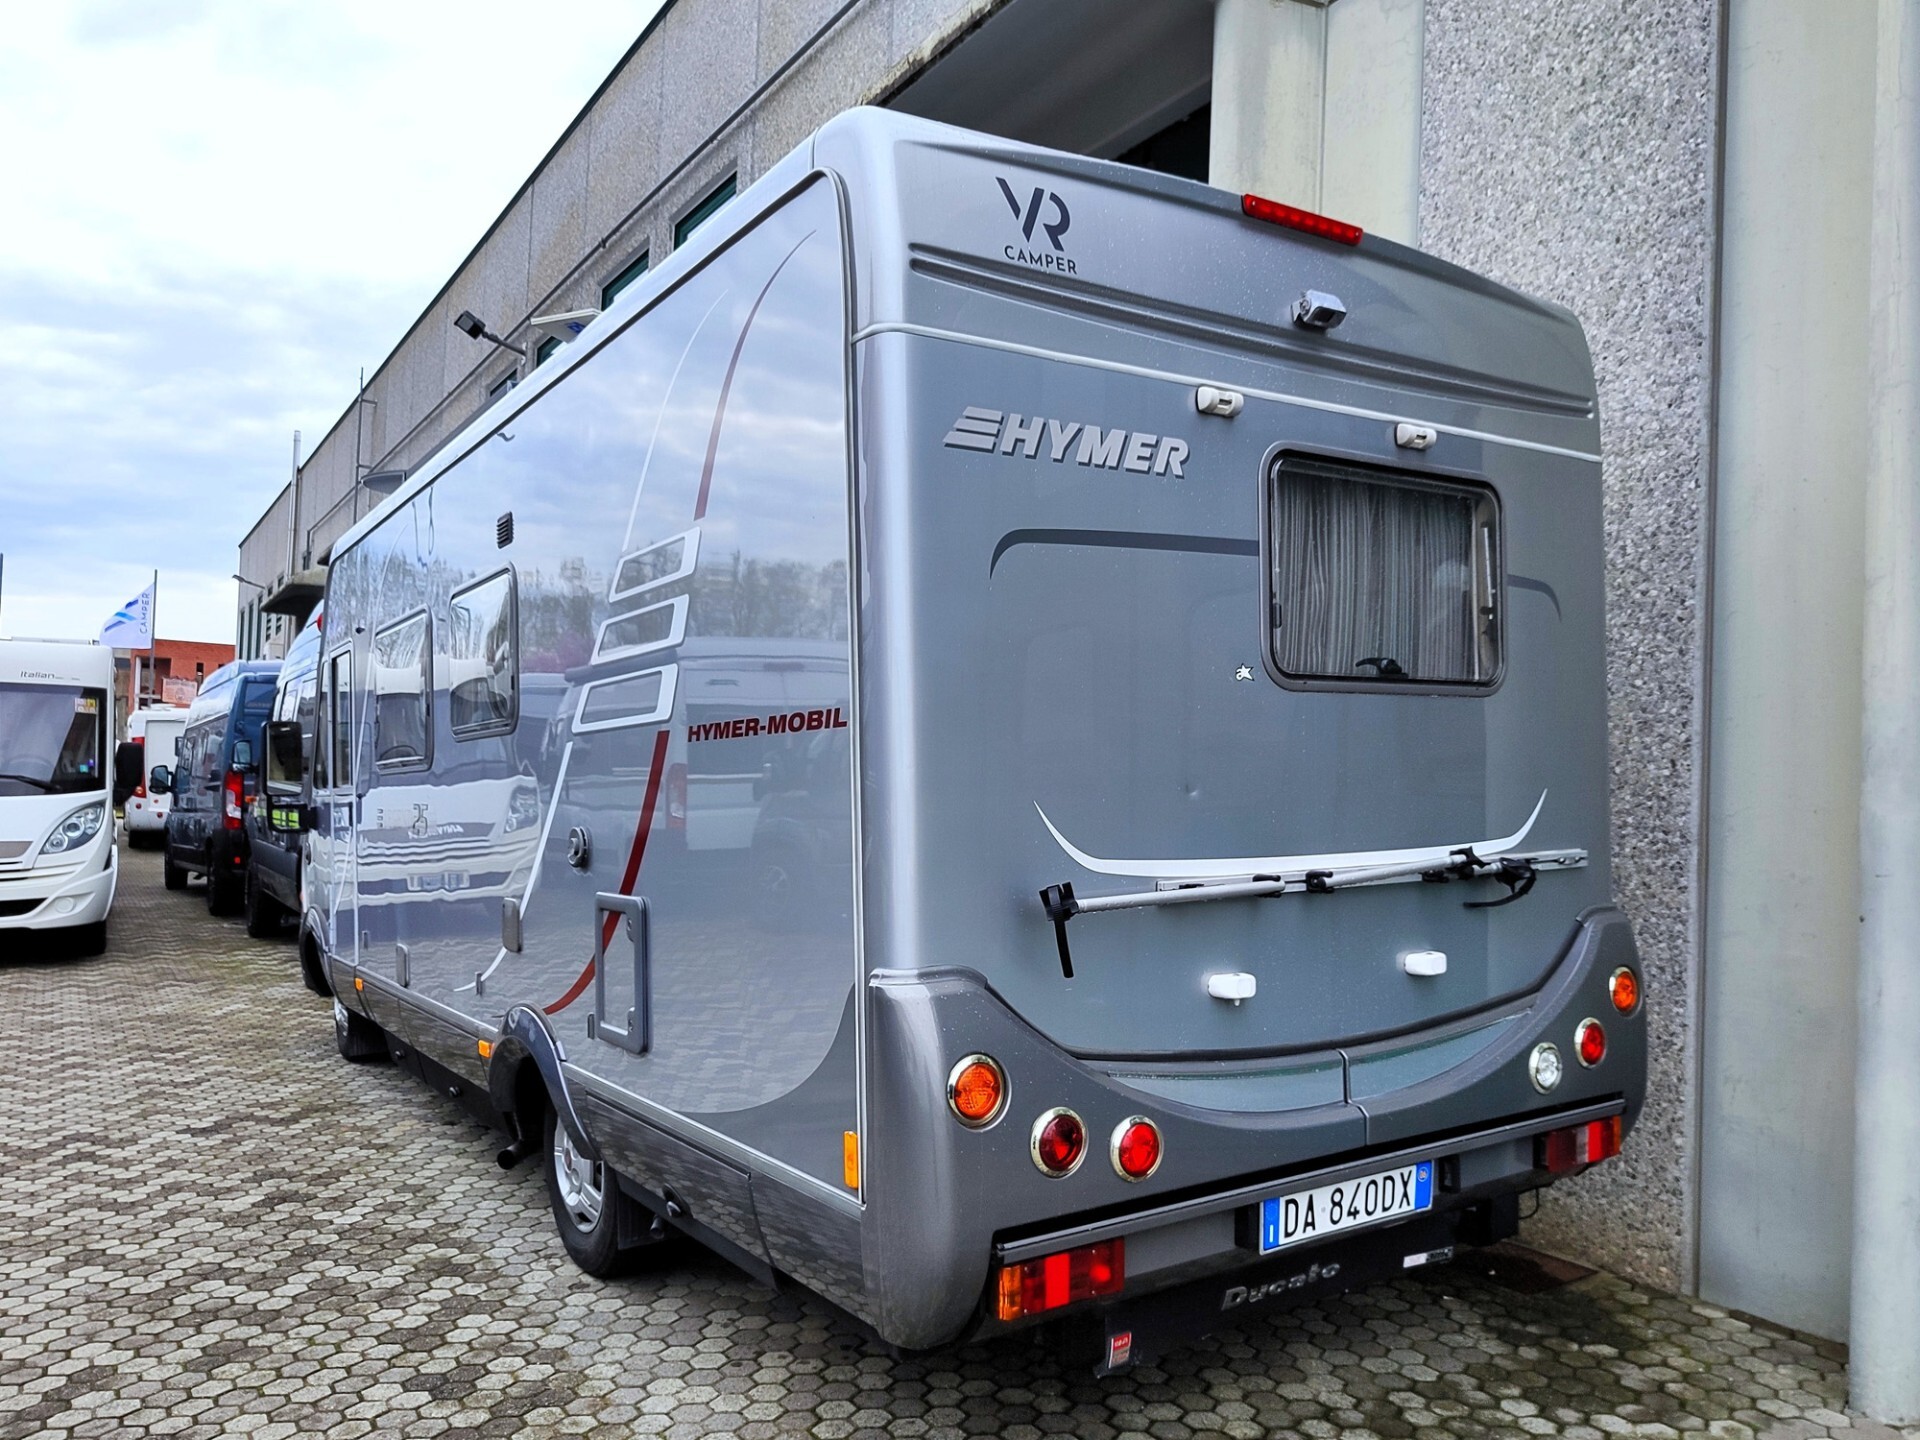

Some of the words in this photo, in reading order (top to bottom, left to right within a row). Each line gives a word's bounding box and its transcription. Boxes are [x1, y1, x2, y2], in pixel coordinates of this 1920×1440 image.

[995, 176, 1071, 252] VR
[1004, 245, 1078, 275] CAMPER
[999, 413, 1191, 479] HYMER
[139, 592, 150, 634] CAMPER
[20, 670, 55, 680] Italian
[687, 707, 848, 743] HYMER-MOBIL
[1284, 1194, 1316, 1239] DA
[1329, 1170, 1413, 1226] 840DX
[1221, 1262, 1341, 1311] Ducato
